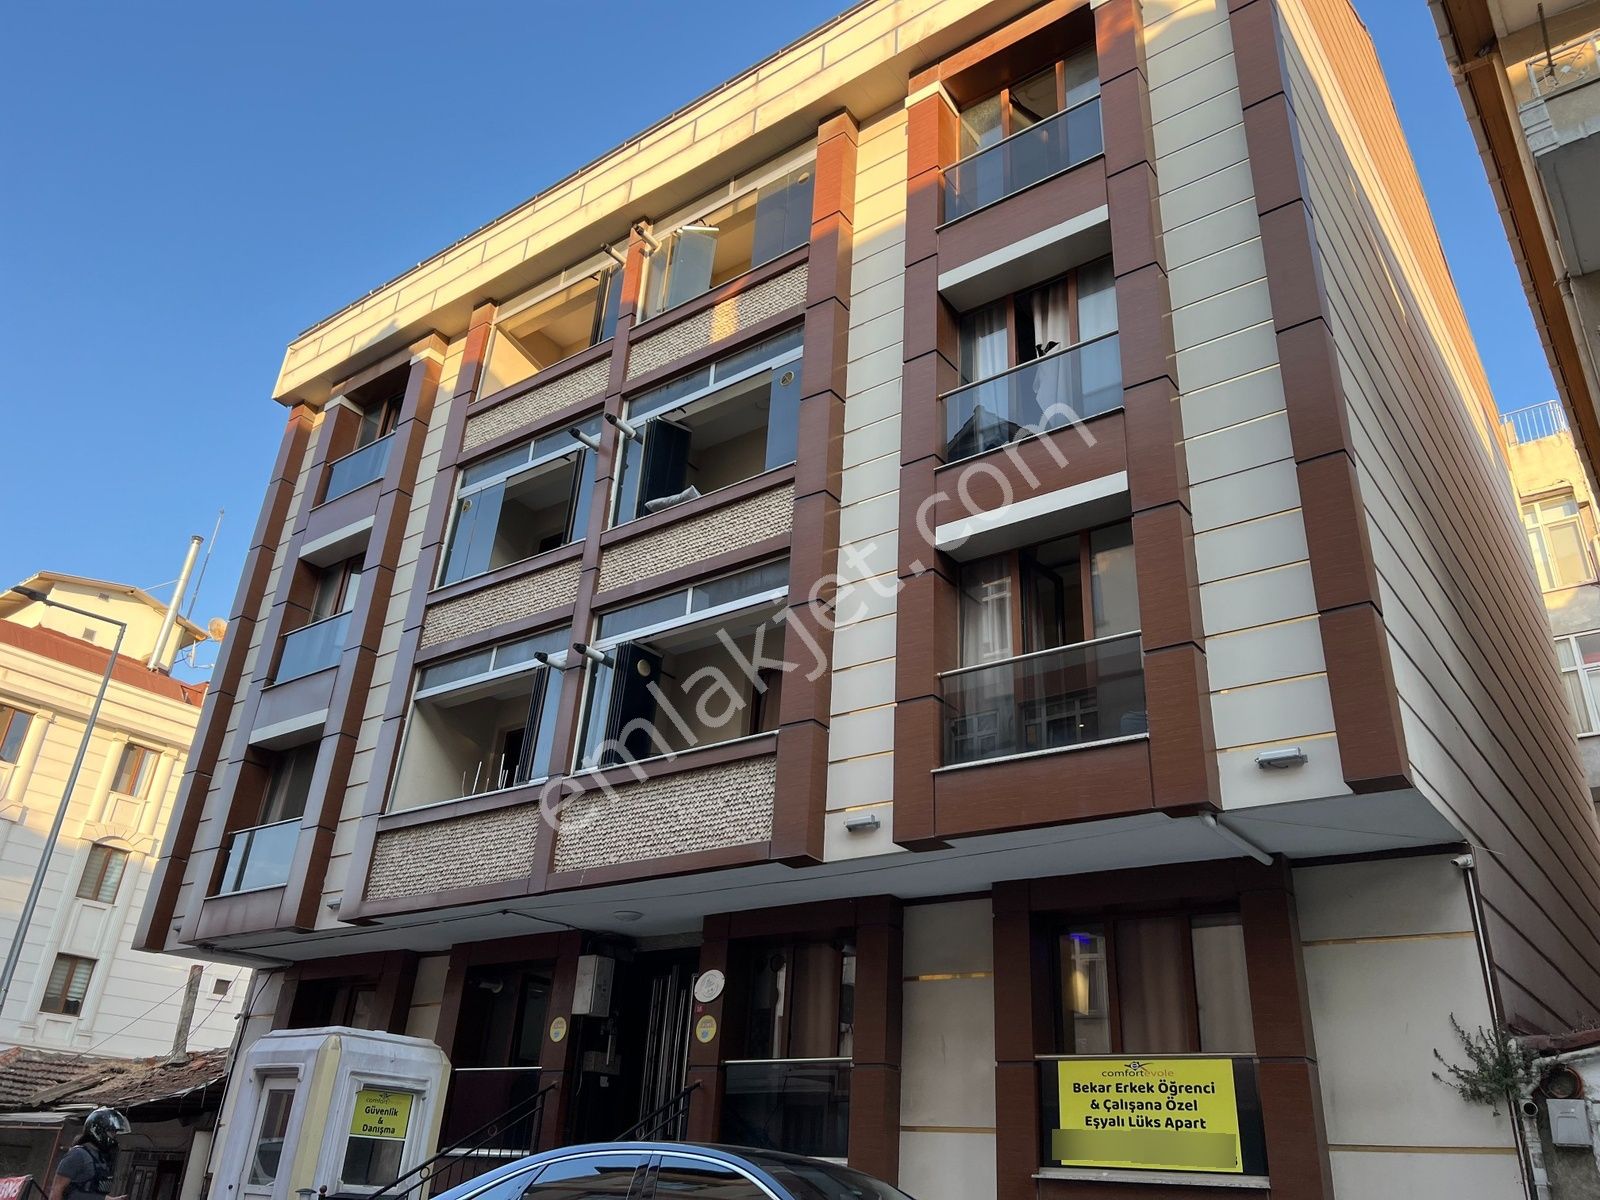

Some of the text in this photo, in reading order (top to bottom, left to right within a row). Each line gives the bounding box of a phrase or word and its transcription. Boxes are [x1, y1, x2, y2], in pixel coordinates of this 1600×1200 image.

[1101, 1068, 1175, 1078] comfortevole
[1073, 1079, 1215, 1096] Bekar Erkek Öğrenci
[364, 1105, 399, 1117] Güvenlik
[1090, 1097, 1198, 1113] & Çalışana Özel
[377, 1116, 384, 1125] &
[1085, 1115, 1206, 1131] Eşyalı Lüks Apart
[362, 1124, 396, 1135] Danışma
